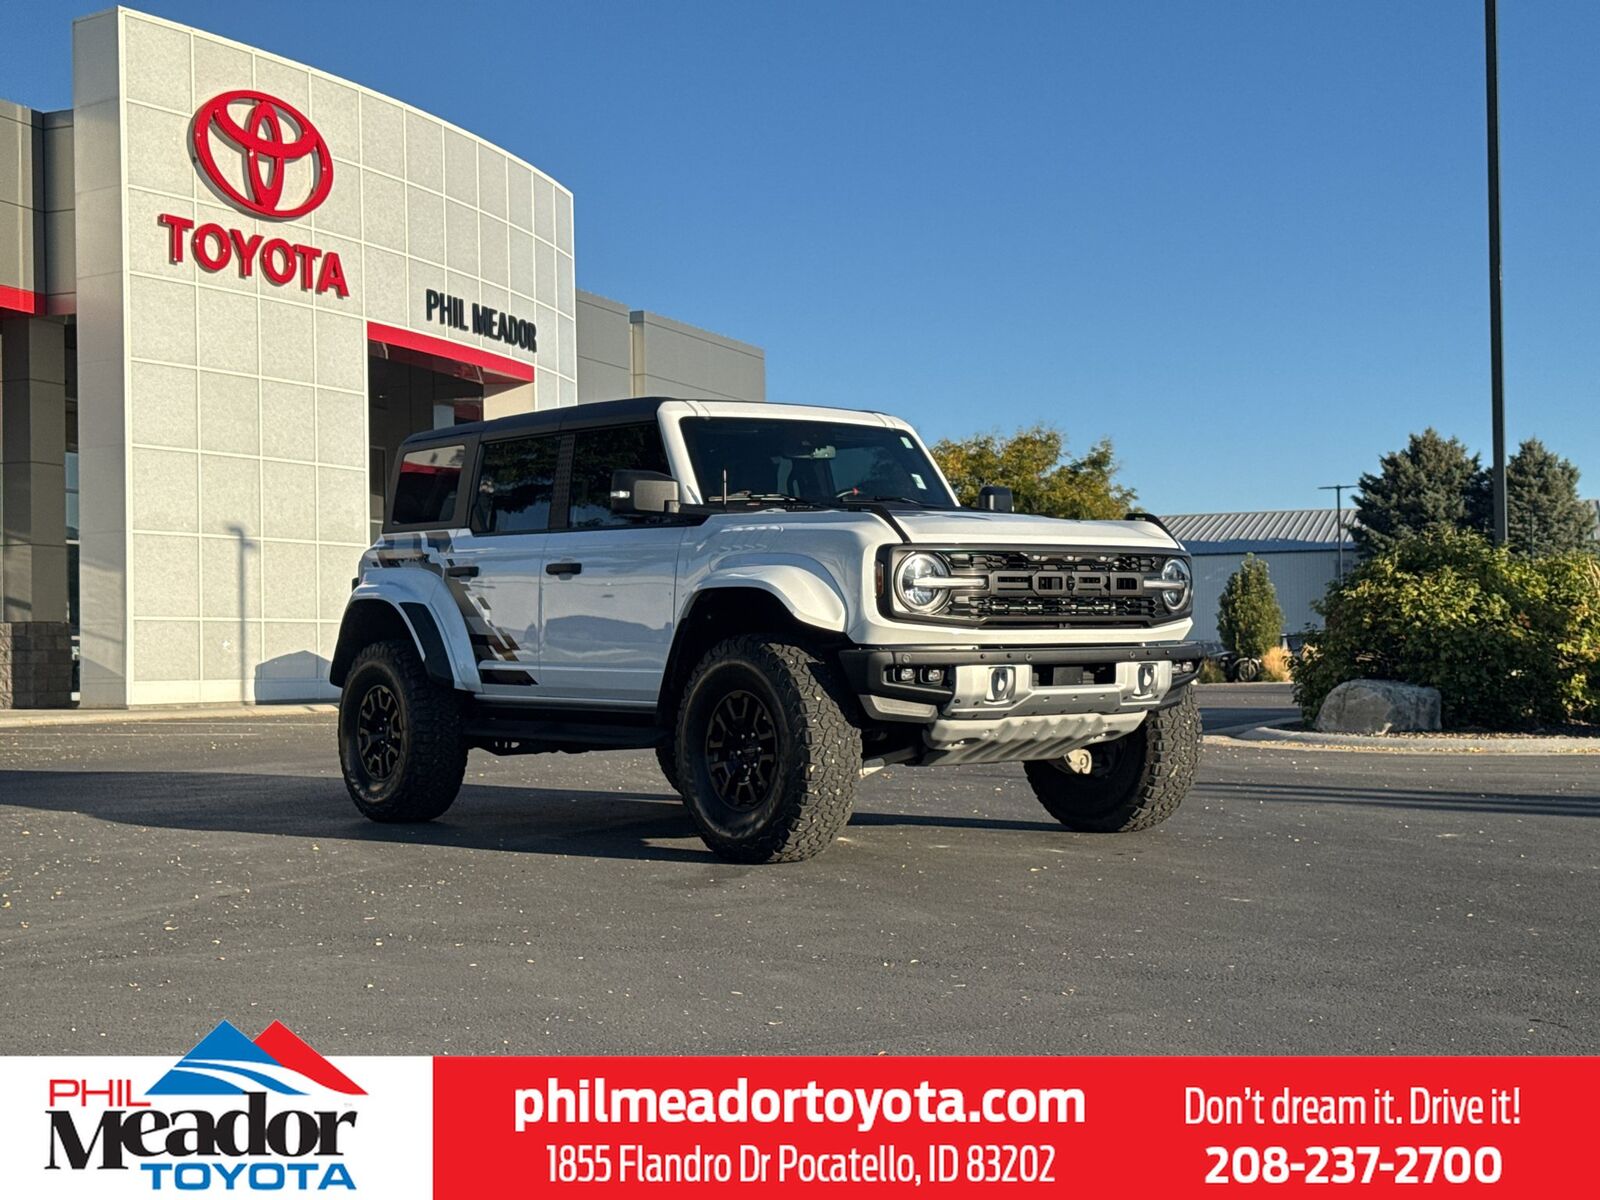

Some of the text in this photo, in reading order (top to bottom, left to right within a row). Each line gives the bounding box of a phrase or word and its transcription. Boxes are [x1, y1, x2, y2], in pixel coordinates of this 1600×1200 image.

[158, 212, 349, 298] TOYOTA
[426, 288, 537, 353] PHIL MEADOR
[990, 570, 1145, 597] FORD
